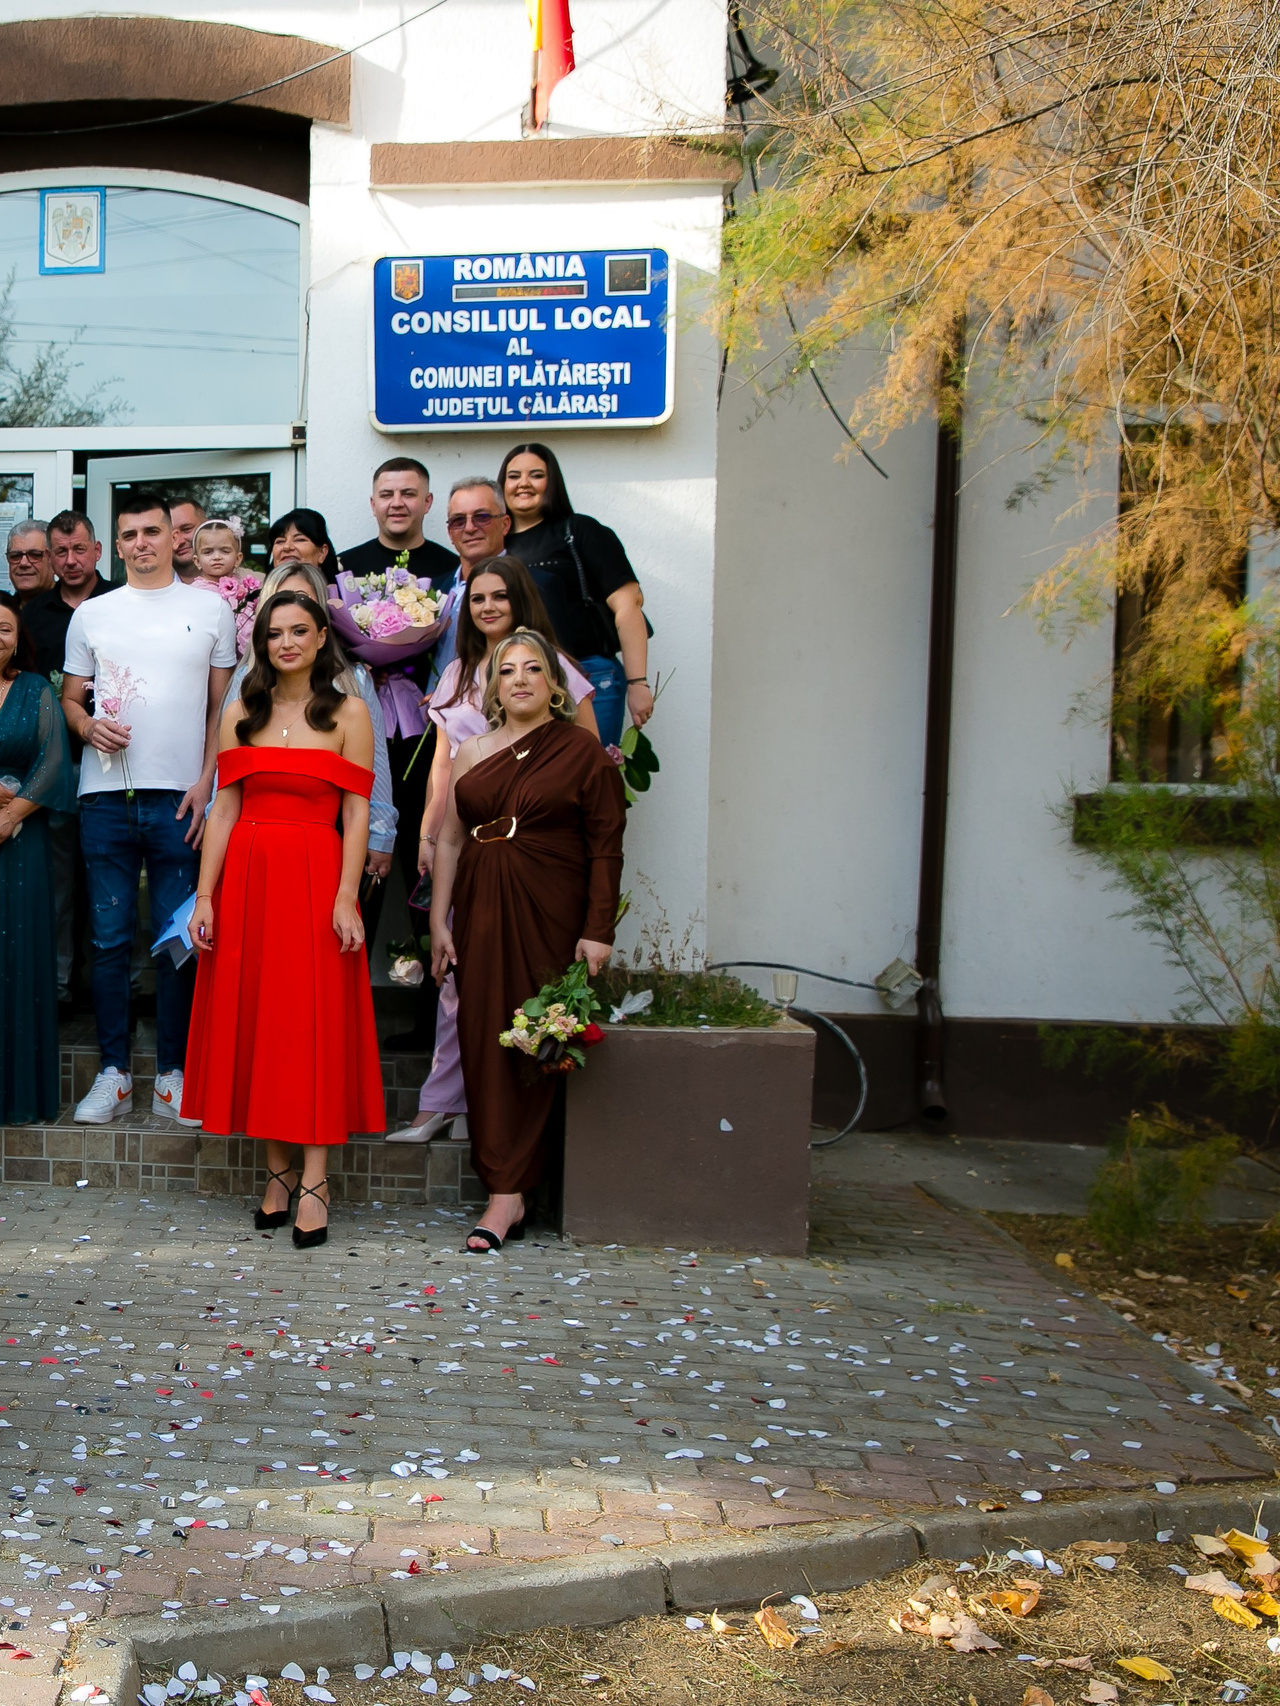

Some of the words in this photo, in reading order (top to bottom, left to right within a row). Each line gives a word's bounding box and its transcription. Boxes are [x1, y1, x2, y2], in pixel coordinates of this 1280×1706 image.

[453, 252, 586, 281] ROMÂNIA
[390, 308, 546, 335] CONSILIUL
[554, 304, 651, 330] LOCAL
[506, 337, 533, 356] AL
[409, 364, 503, 389] COMUNEI
